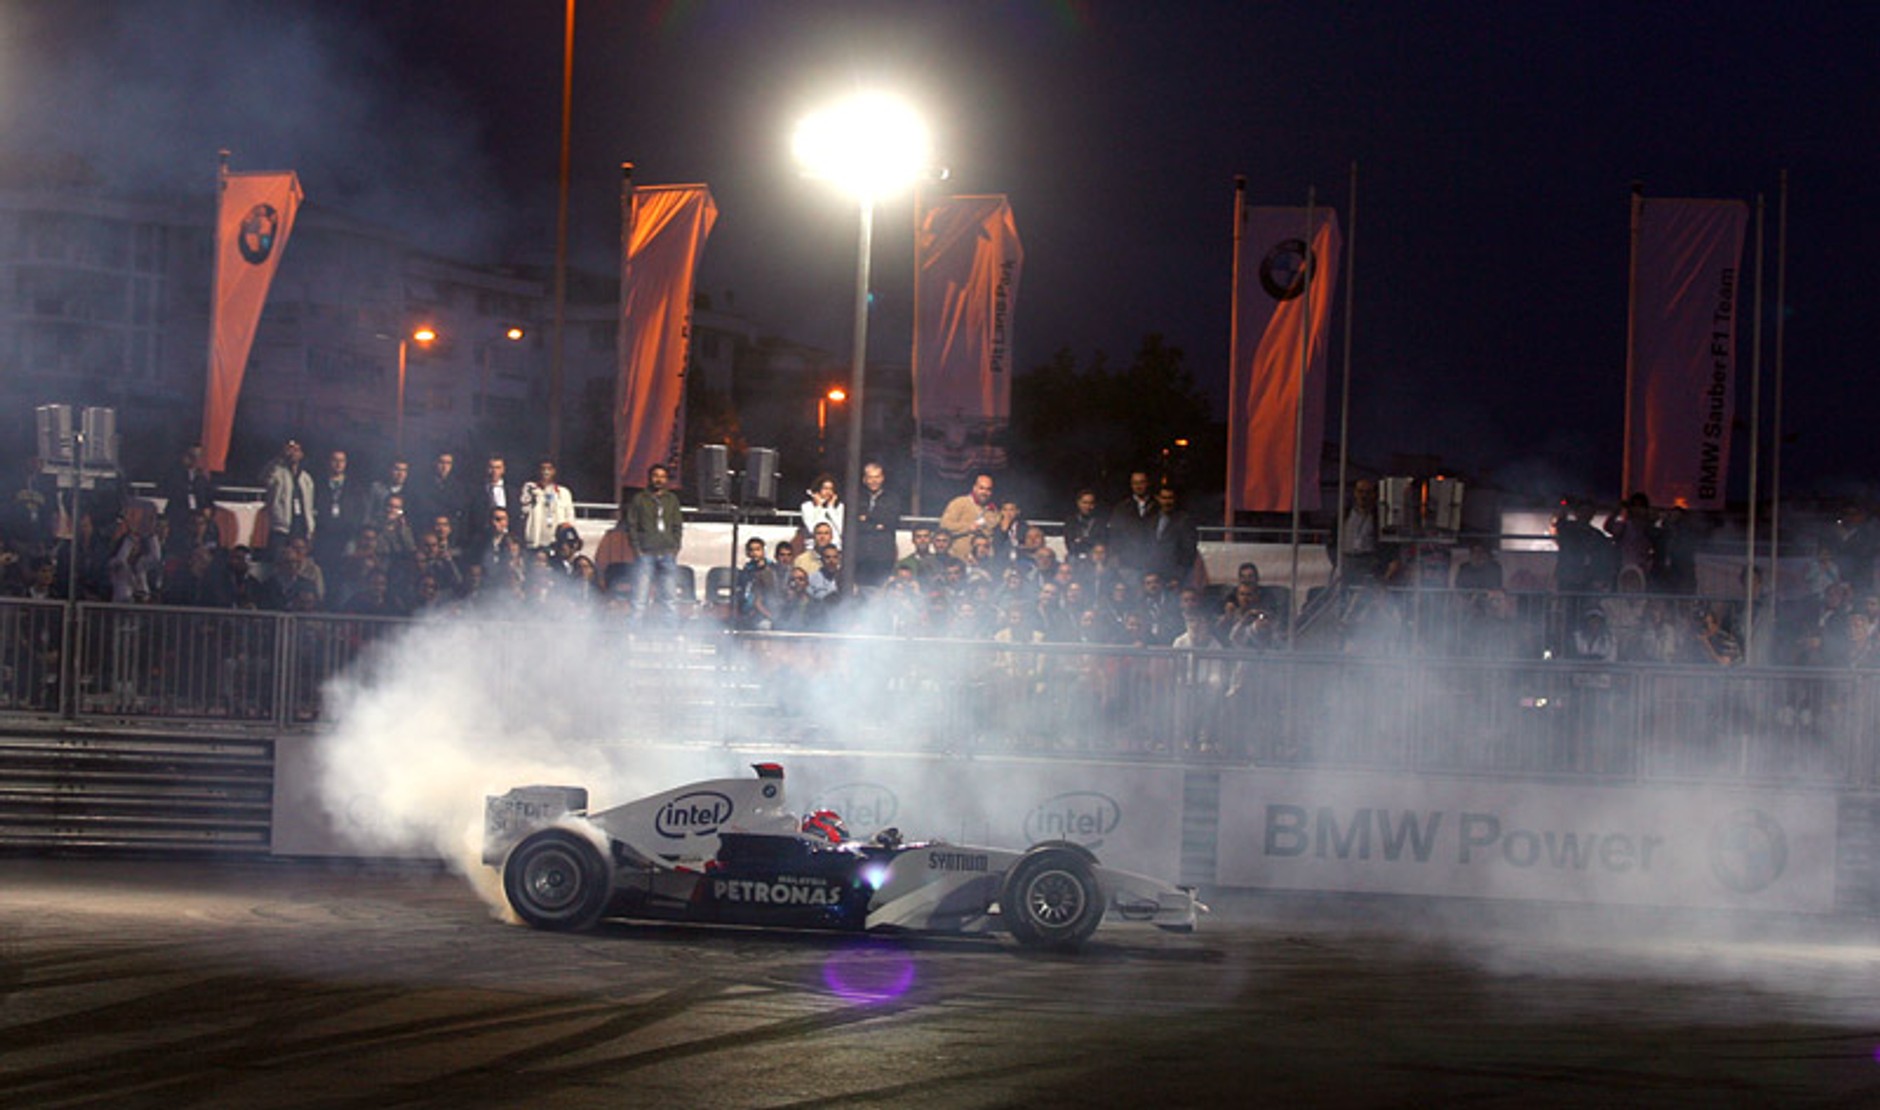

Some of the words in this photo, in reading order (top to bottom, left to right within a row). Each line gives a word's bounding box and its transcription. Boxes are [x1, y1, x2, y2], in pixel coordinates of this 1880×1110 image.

[1714, 267, 1736, 327] Team
[1711, 331, 1730, 357] F1
[1704, 362, 1728, 440] Sauber
[1699, 443, 1719, 501] BMW
[666, 801, 721, 826] intel
[1036, 806, 1106, 837] intel
[1263, 803, 1443, 863] BMW
[1458, 812, 1665, 872] Power
[714, 879, 842, 905] PETRONAS
